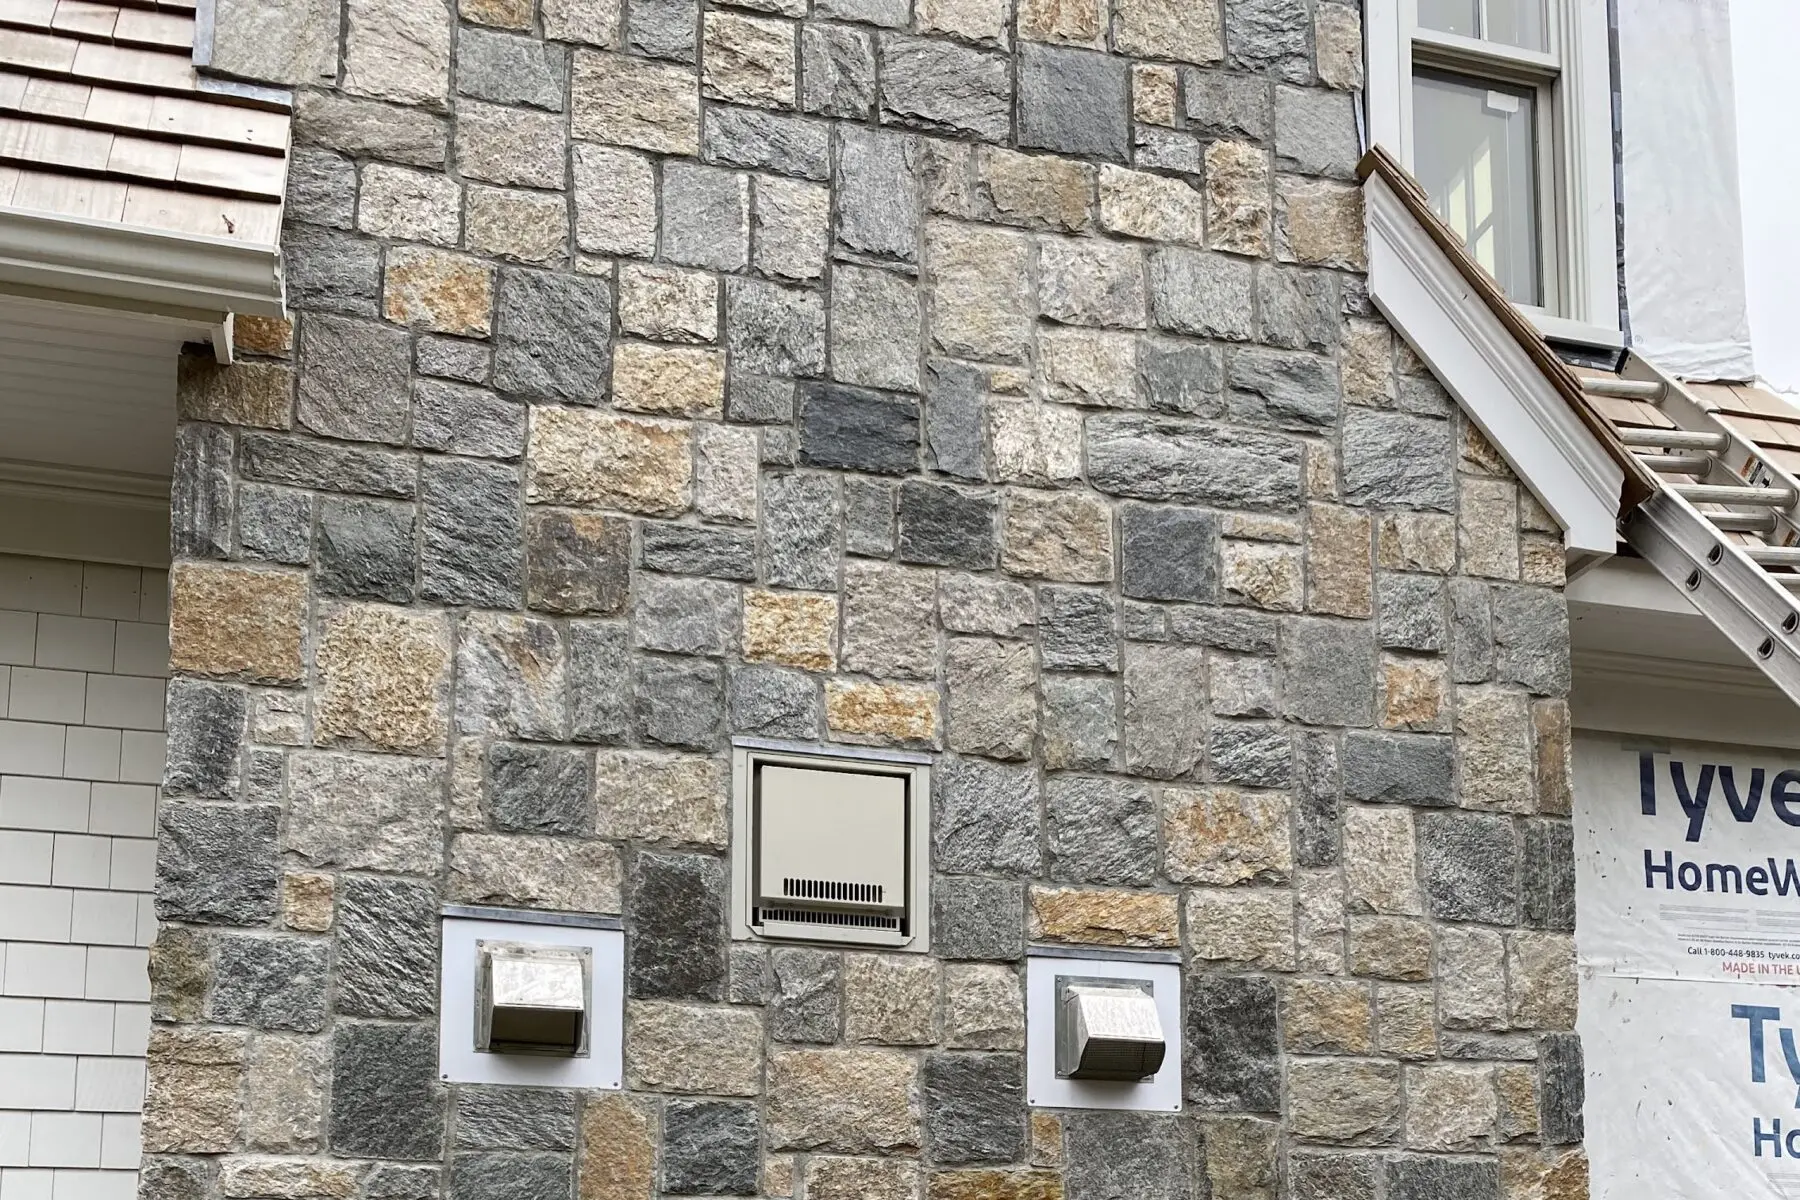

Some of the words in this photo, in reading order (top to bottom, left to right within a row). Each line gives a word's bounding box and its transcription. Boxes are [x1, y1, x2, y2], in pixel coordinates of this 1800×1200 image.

[1622, 744, 1800, 842] Tyve
[1644, 850, 1800, 897] HomeW
[1687, 947, 1703, 955] Call
[1704, 948, 1765, 958] 1-800-448-9835
[1722, 962, 1756, 974] MADE
[1758, 964, 1770, 975] IN
[1772, 964, 1793, 976] THE
[1753, 1117, 1800, 1160] Ho
